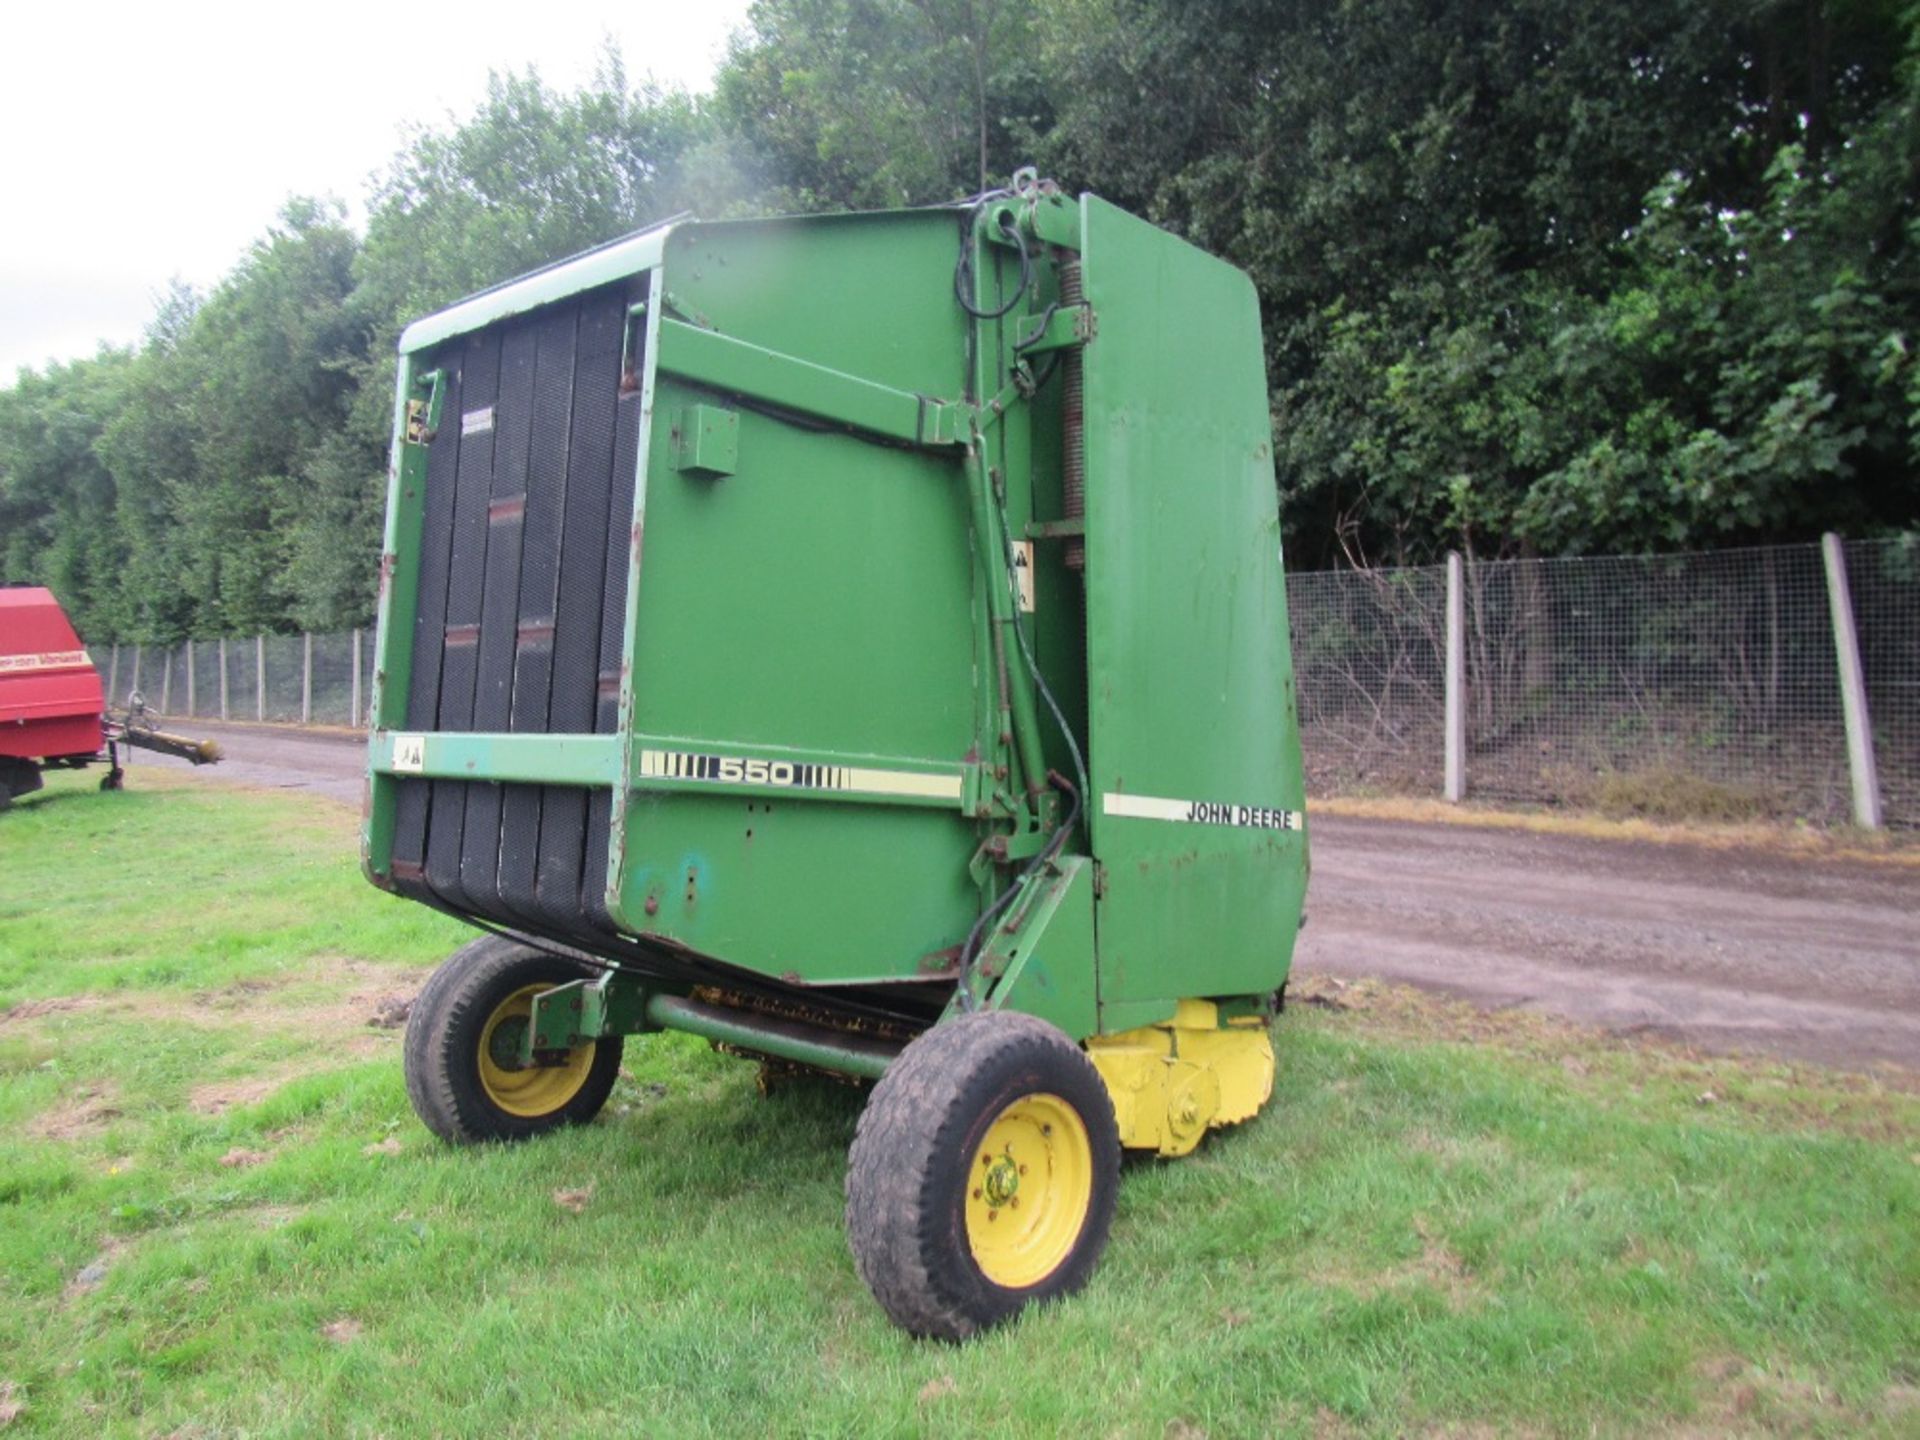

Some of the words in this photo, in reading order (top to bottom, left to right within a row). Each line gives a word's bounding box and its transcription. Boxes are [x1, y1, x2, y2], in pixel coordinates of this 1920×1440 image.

[718, 757, 794, 785] 550
[1187, 801, 1232, 823] JOHN
[1239, 805, 1293, 830] DEERE
